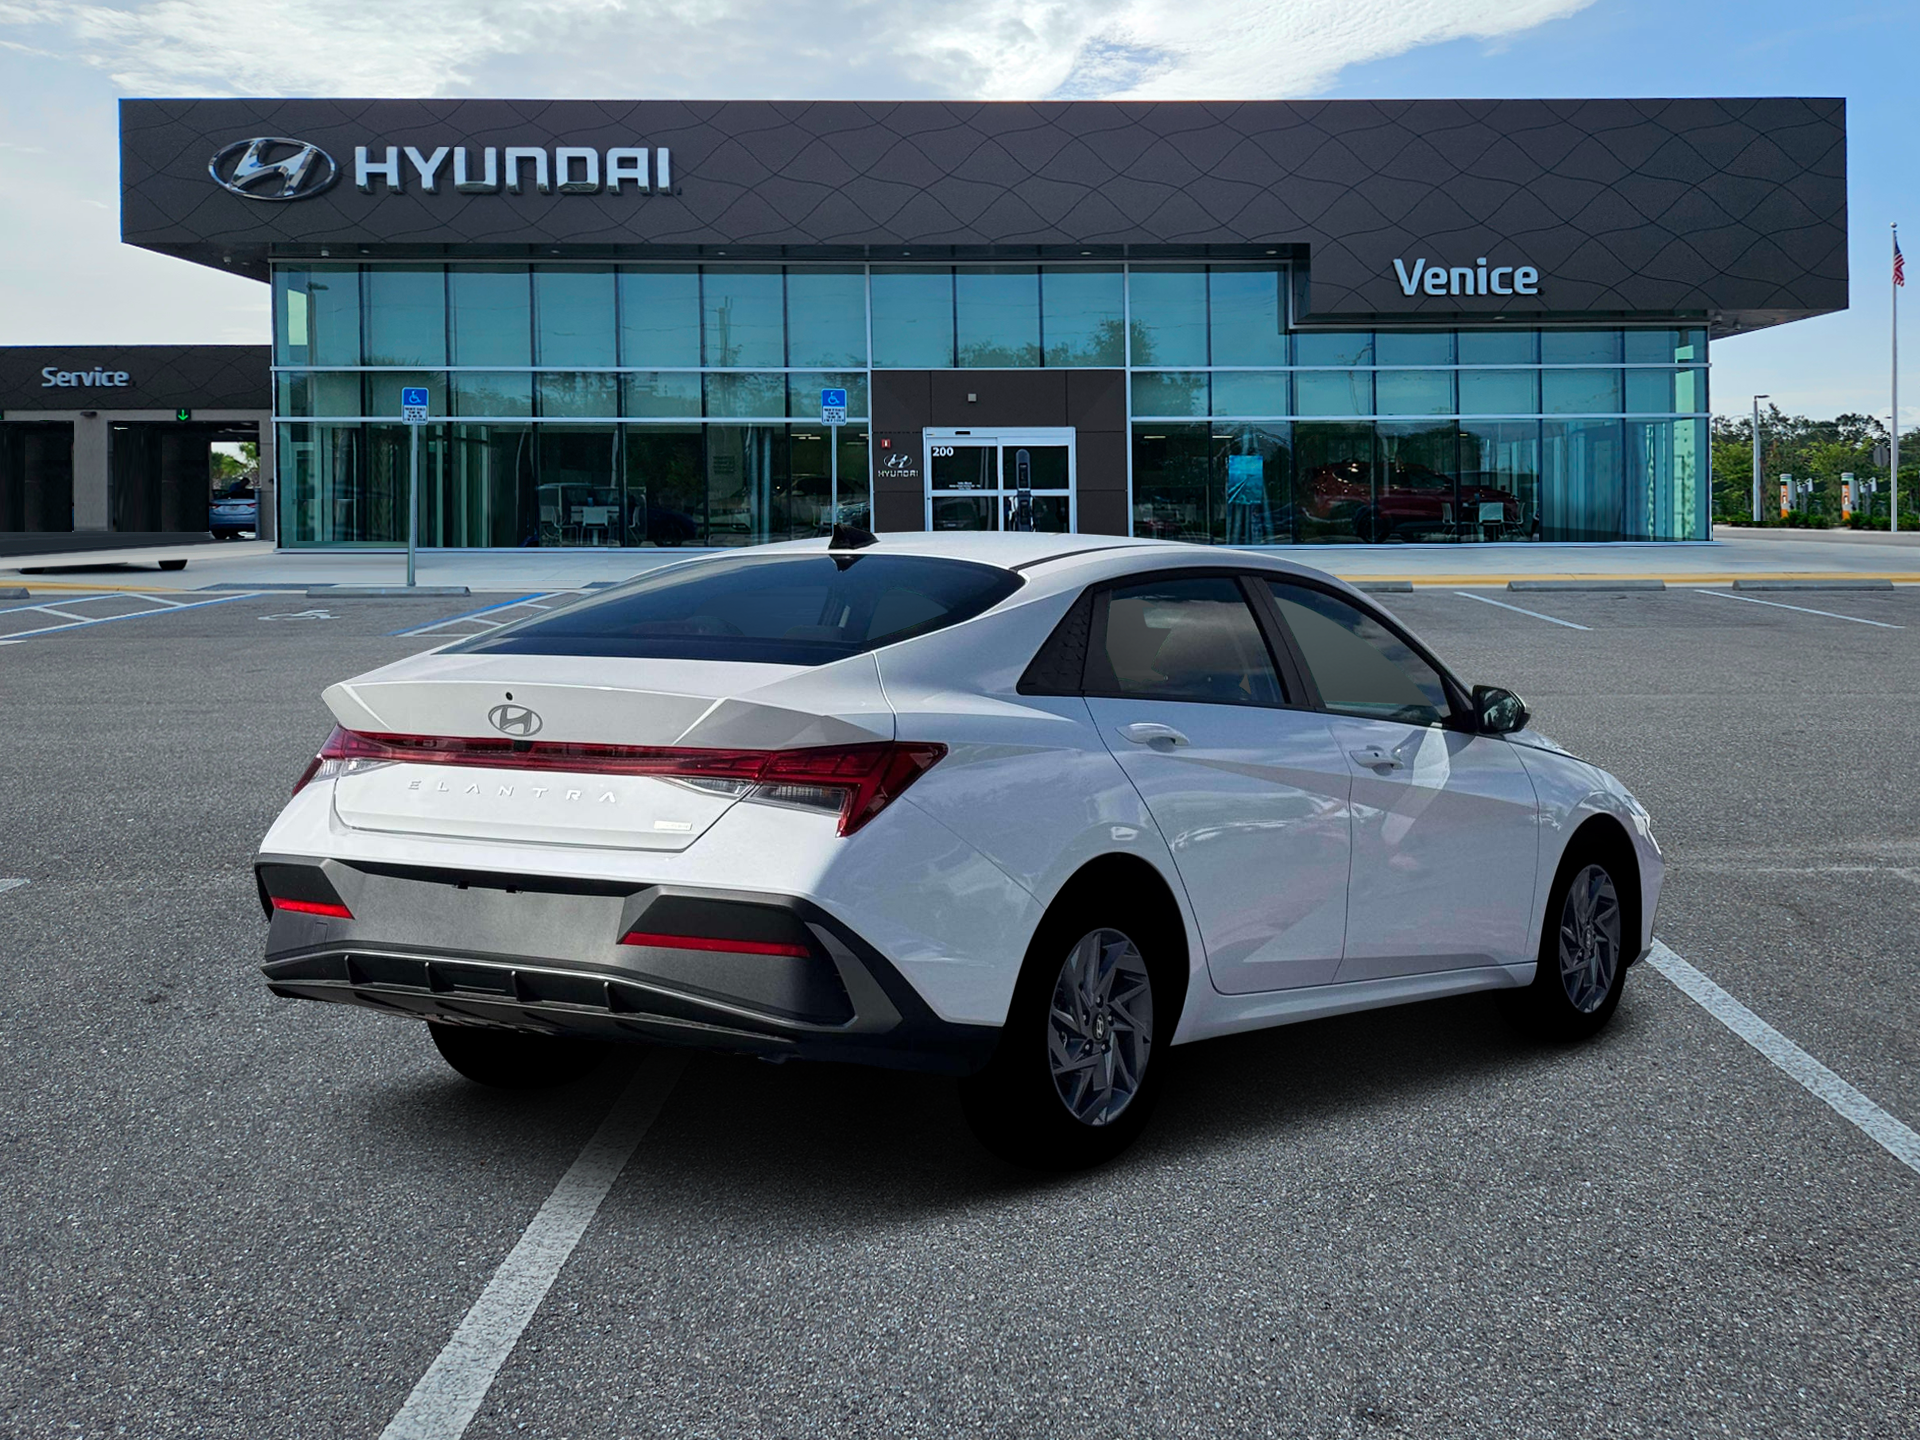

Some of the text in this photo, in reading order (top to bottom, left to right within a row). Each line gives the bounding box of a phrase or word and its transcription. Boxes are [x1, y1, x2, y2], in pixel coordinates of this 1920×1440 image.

[354, 146, 670, 194] HYUNDAI
[1393, 257, 1539, 296] Venice
[41, 367, 130, 387] Service
[932, 447, 954, 457] 200
[408, 780, 616, 803] ELANTRA
